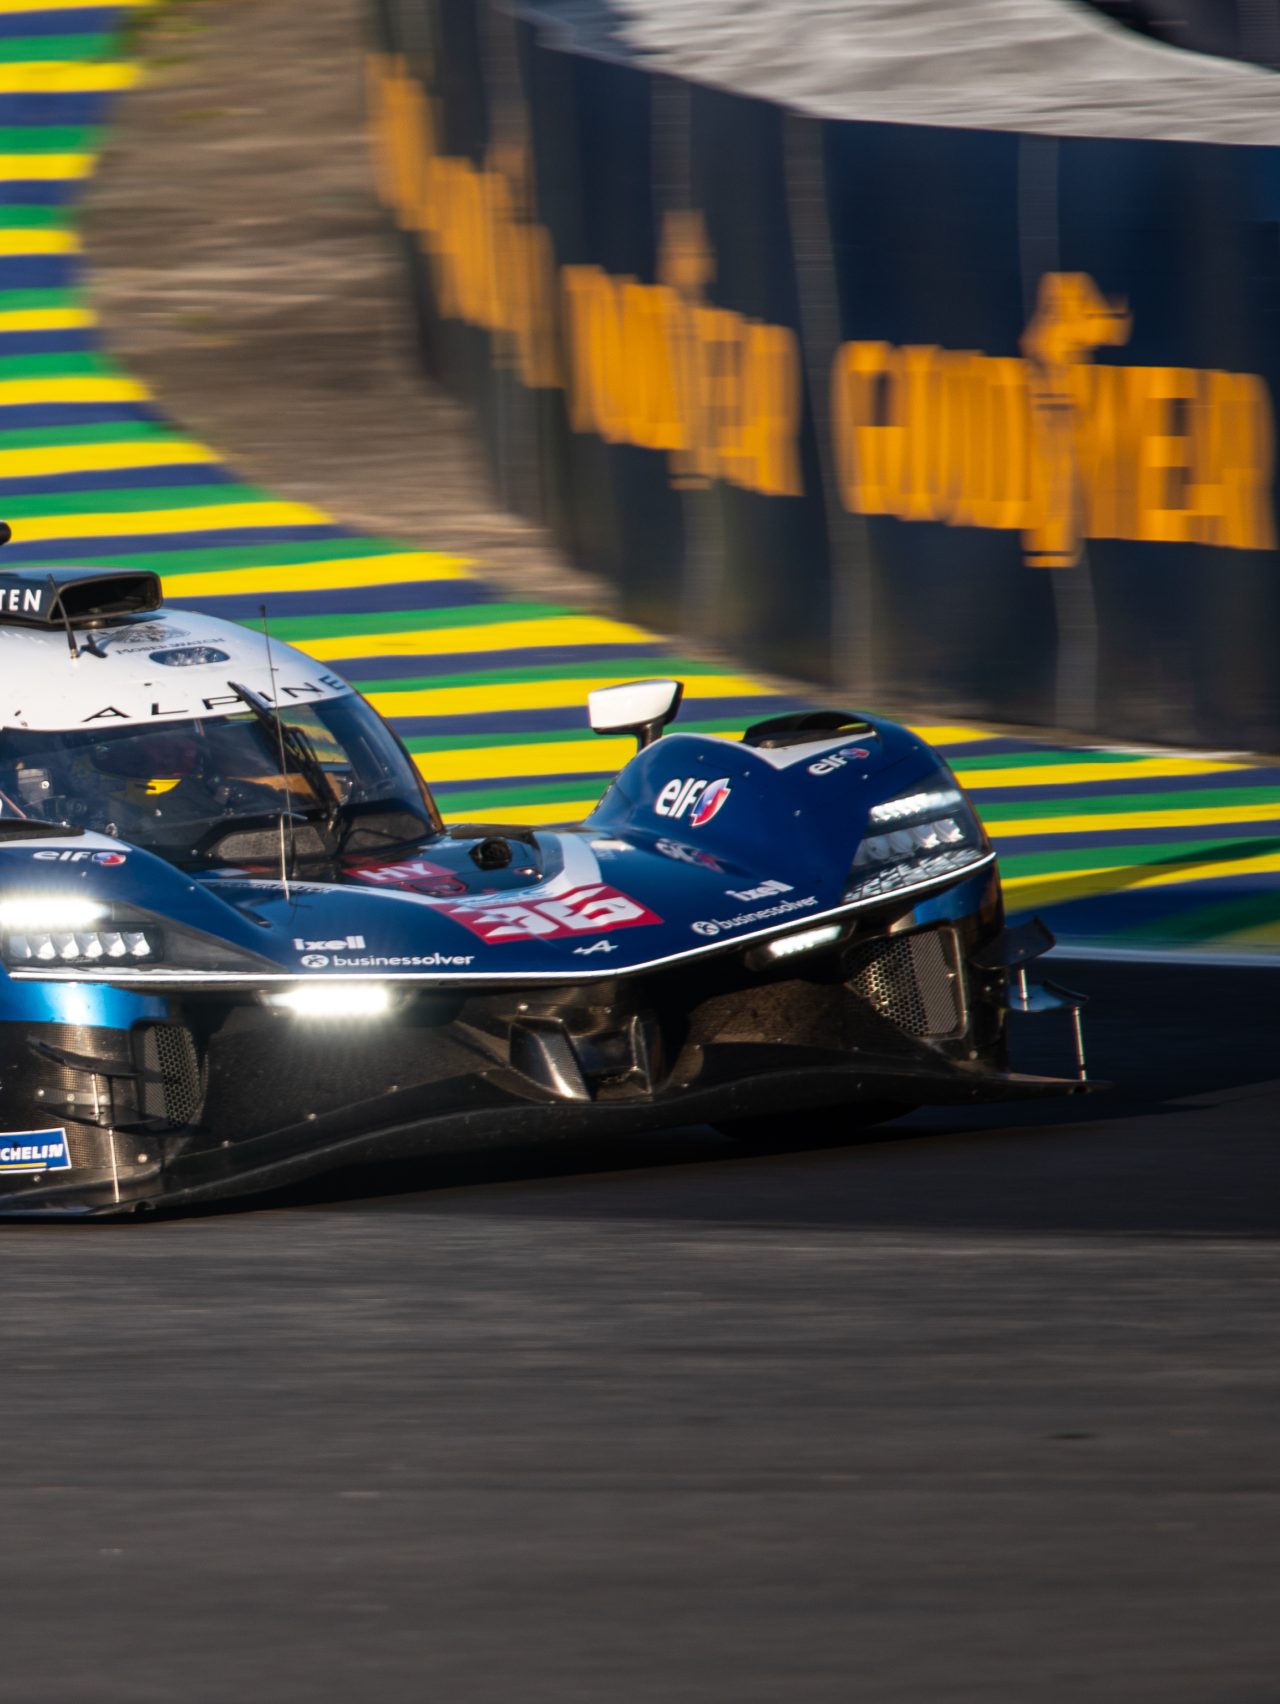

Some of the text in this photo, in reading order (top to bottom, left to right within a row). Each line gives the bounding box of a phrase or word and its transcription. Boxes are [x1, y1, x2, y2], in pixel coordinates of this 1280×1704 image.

[82, 674, 346, 722] ALPINE
[808, 755, 847, 775] elf
[655, 778, 707, 819] elf
[33, 850, 91, 862] elf
[356, 862, 433, 881] HY
[720, 896, 818, 930] businessolver
[333, 952, 476, 968] businessolver
